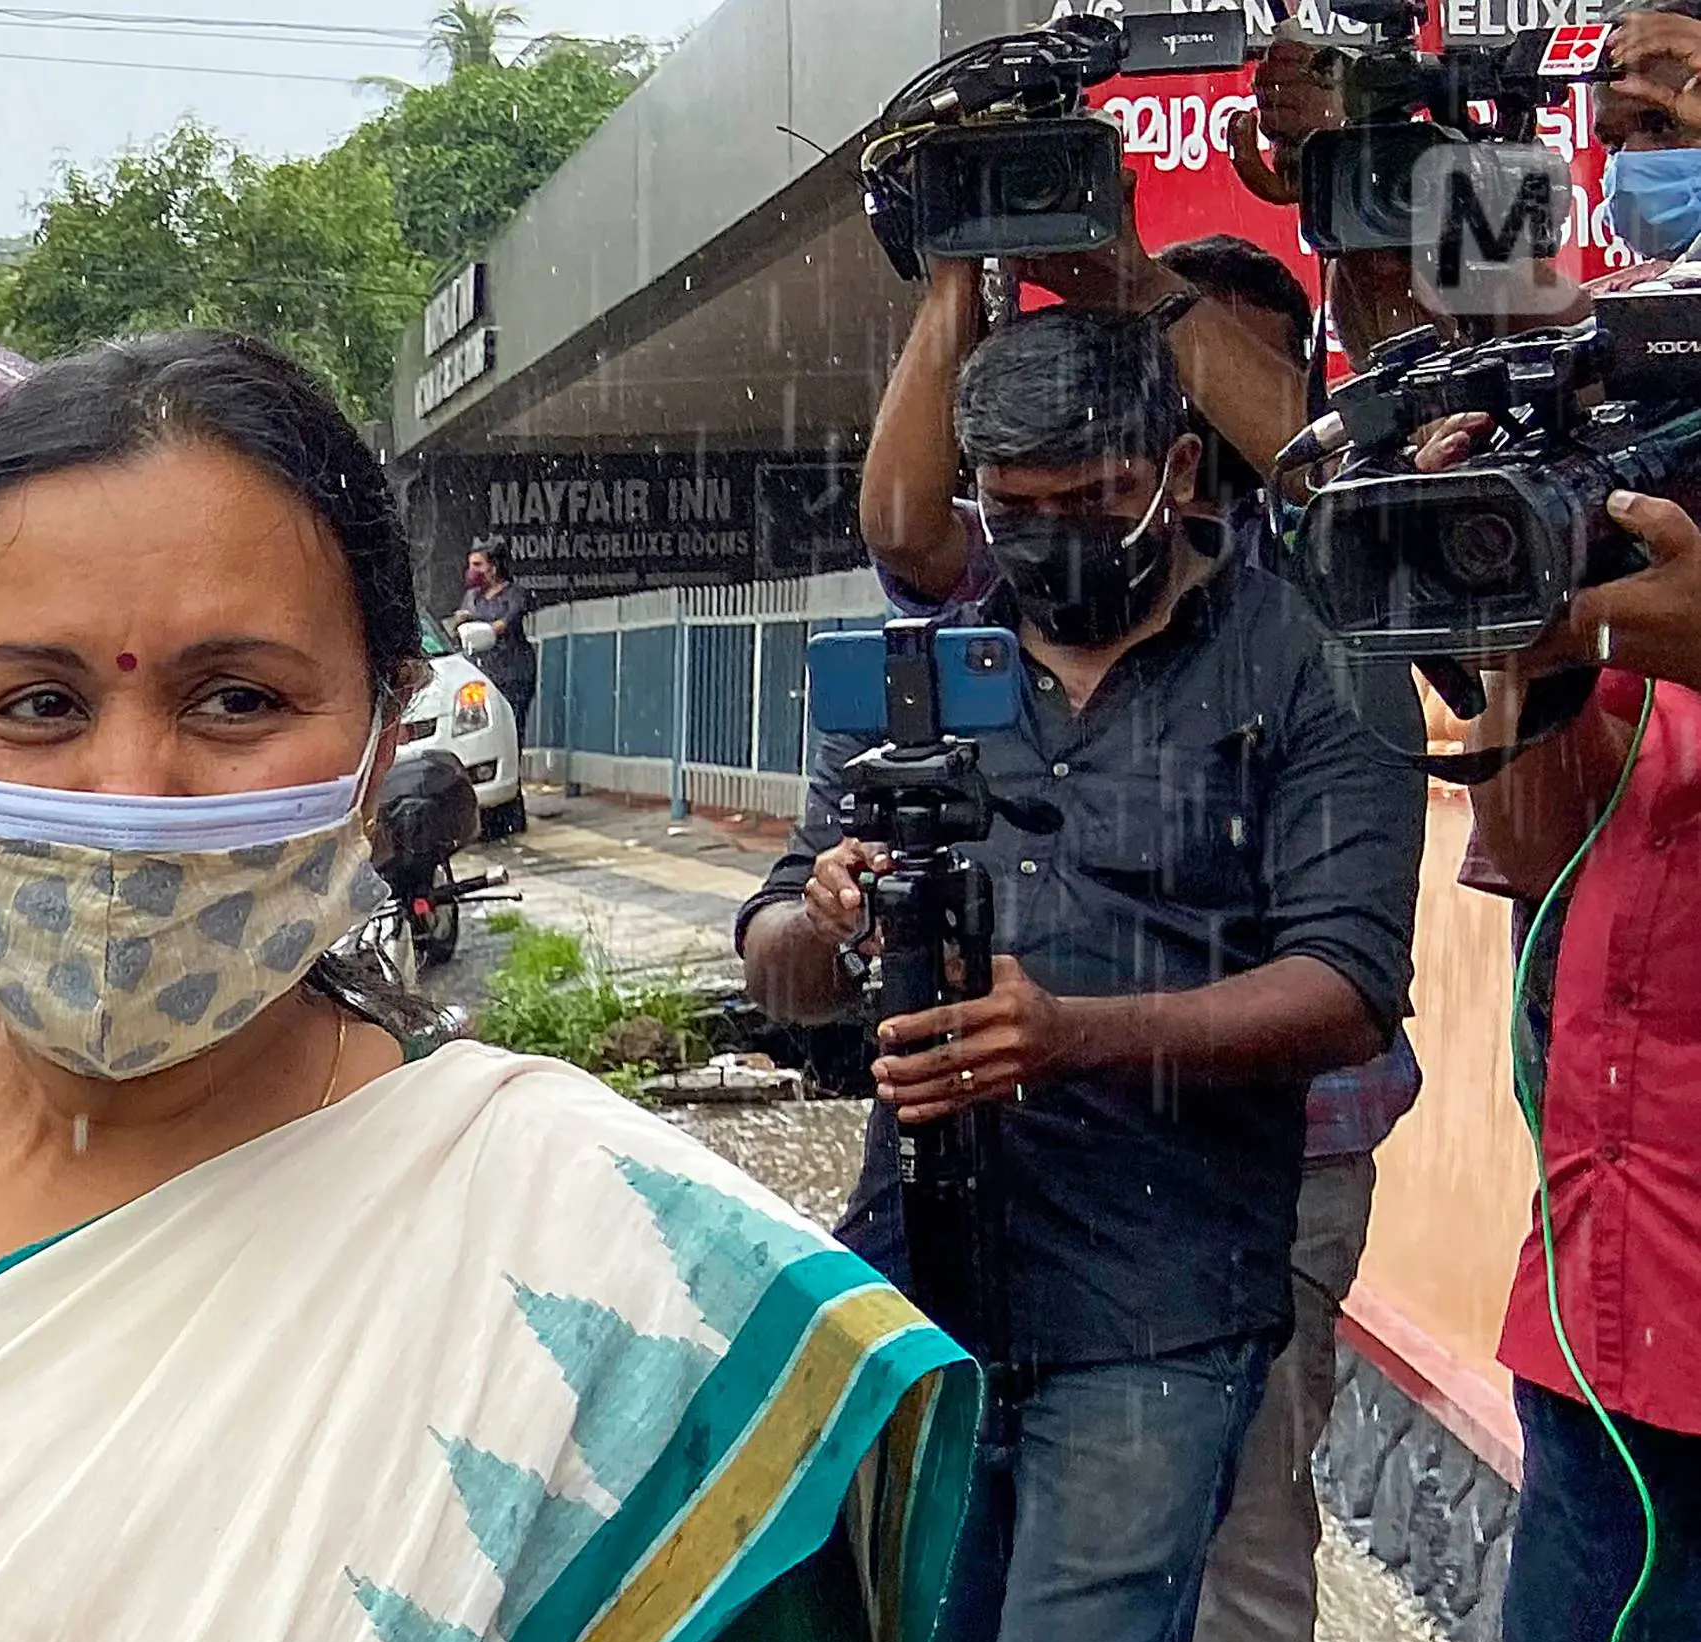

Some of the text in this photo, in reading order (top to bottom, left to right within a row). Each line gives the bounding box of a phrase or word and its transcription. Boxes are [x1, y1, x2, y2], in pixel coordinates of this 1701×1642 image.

[1440, 0, 1603, 35] ELUXE
[489, 477, 732, 525] MAYFAIR INN
